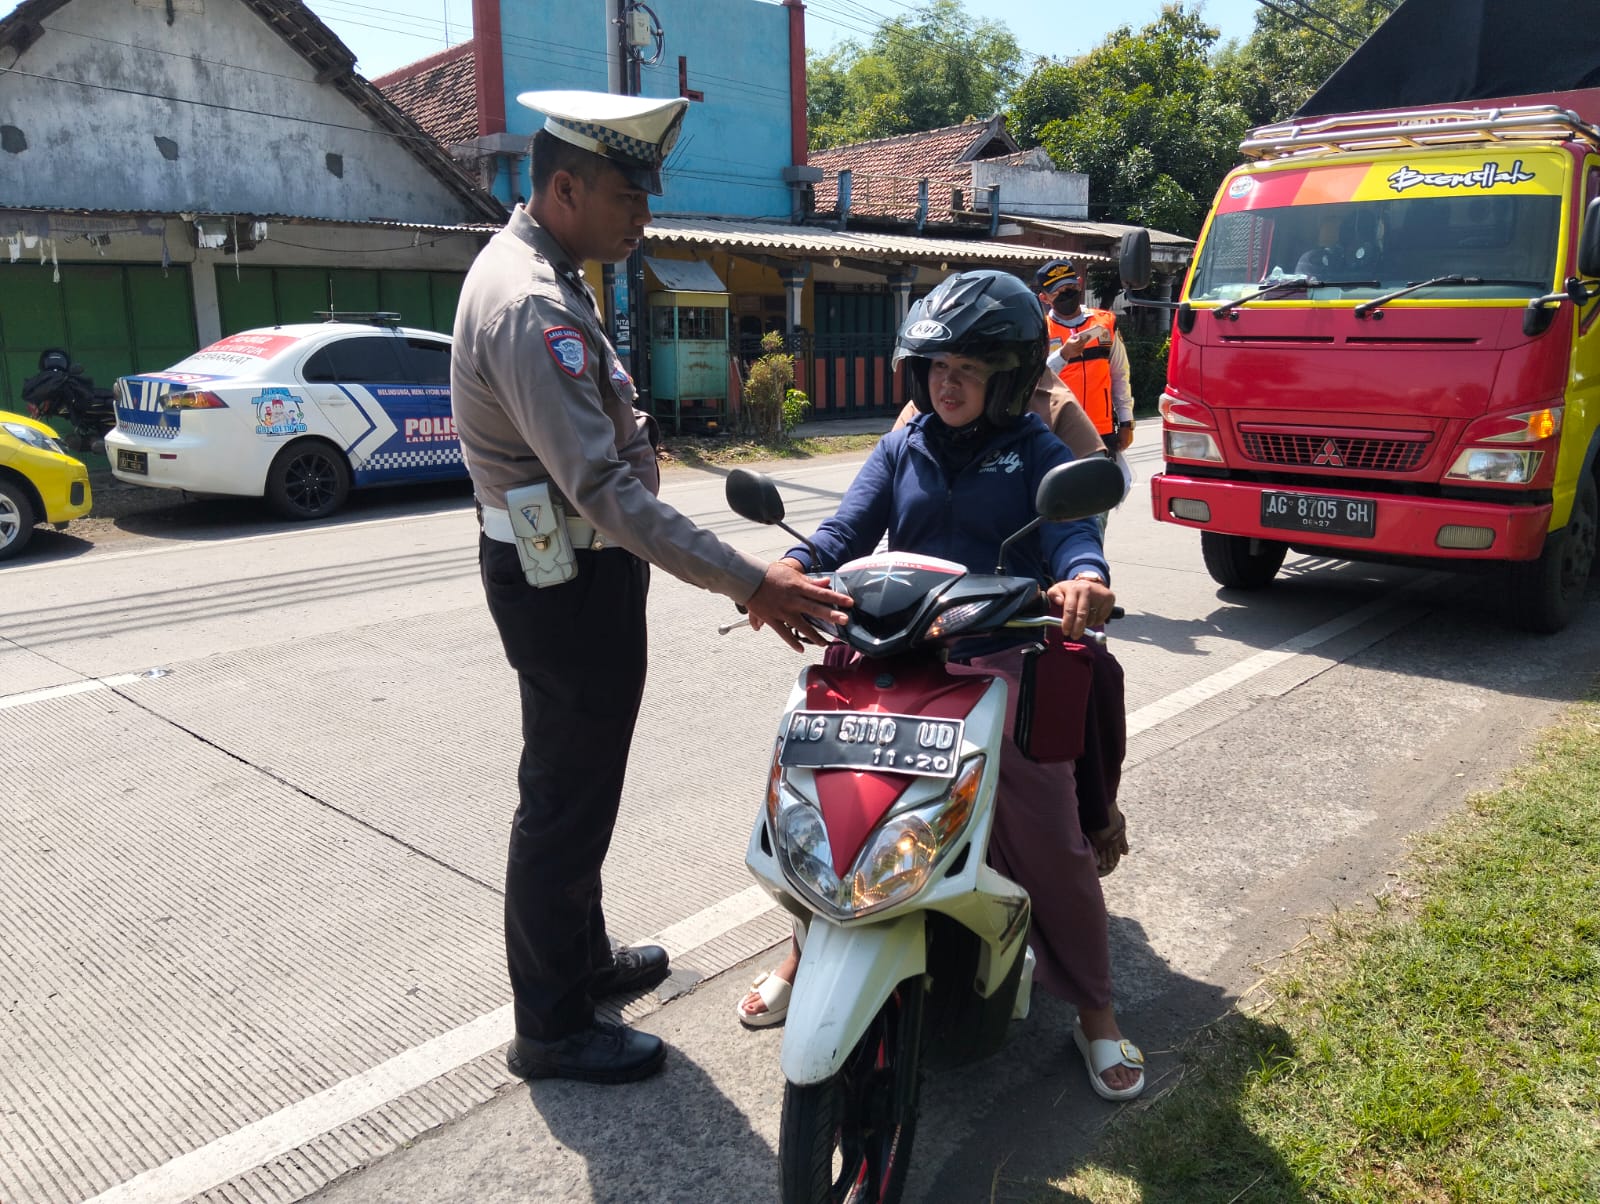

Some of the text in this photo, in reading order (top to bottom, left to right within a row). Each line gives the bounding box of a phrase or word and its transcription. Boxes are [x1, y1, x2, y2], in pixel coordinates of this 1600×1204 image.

[406, 435, 432, 443] LALU
[1268, 495, 1369, 522] AG 8705 GH
[790, 714, 955, 750] AG 5110 UD
